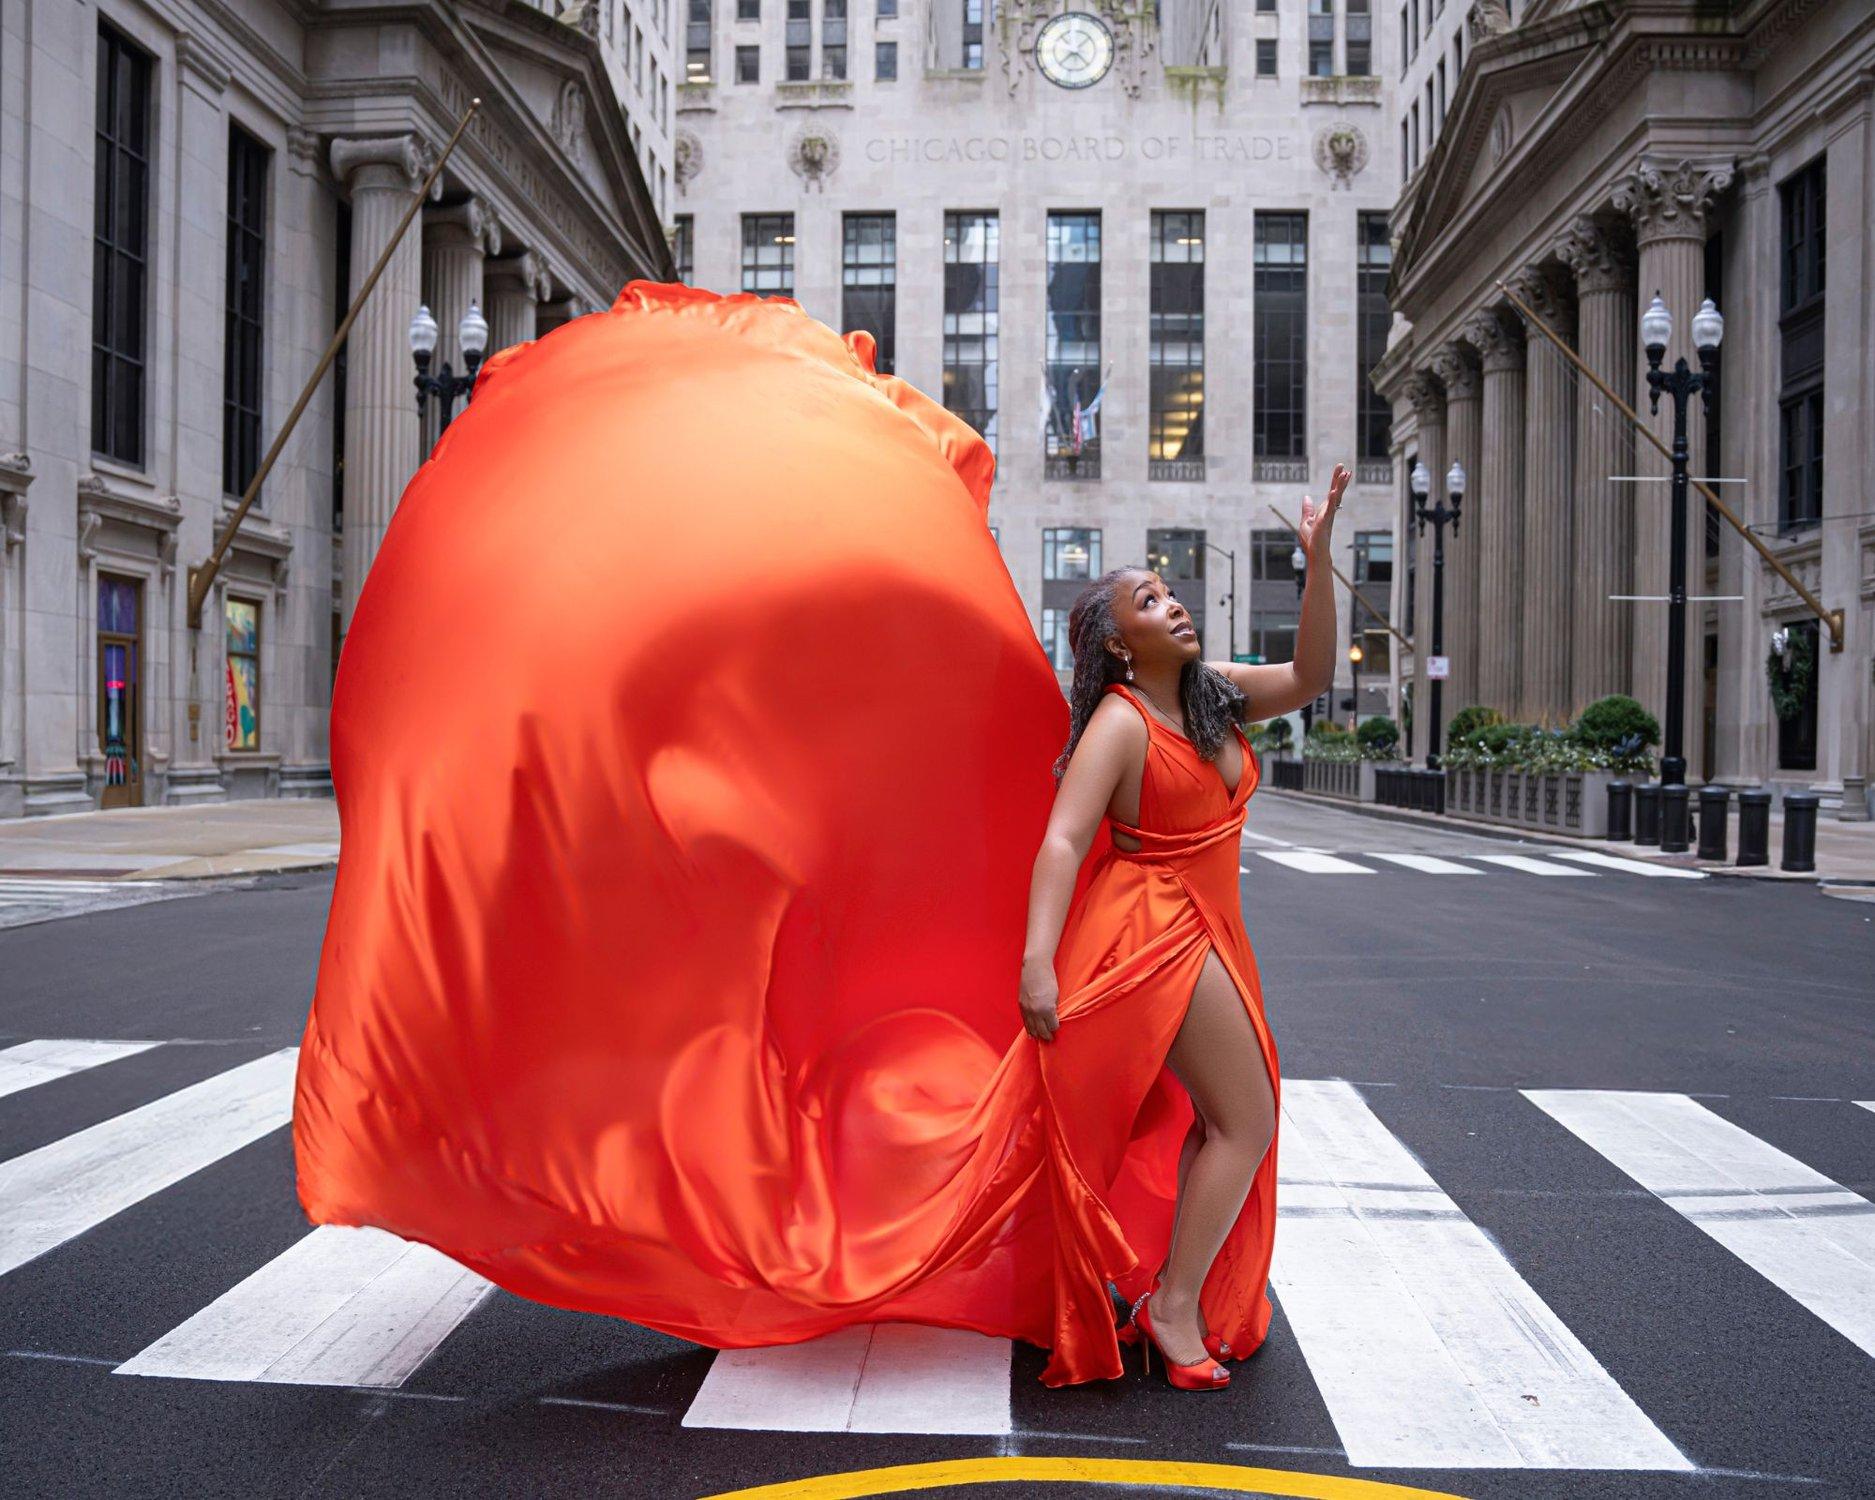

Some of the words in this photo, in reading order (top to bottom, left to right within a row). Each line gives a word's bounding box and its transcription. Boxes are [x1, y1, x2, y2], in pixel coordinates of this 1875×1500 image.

[865, 136, 1009, 163] CHICAGO
[1022, 136, 1125, 161] BOARD
[1141, 136, 1180, 161] OF
[1194, 136, 1292, 161] TRADE
